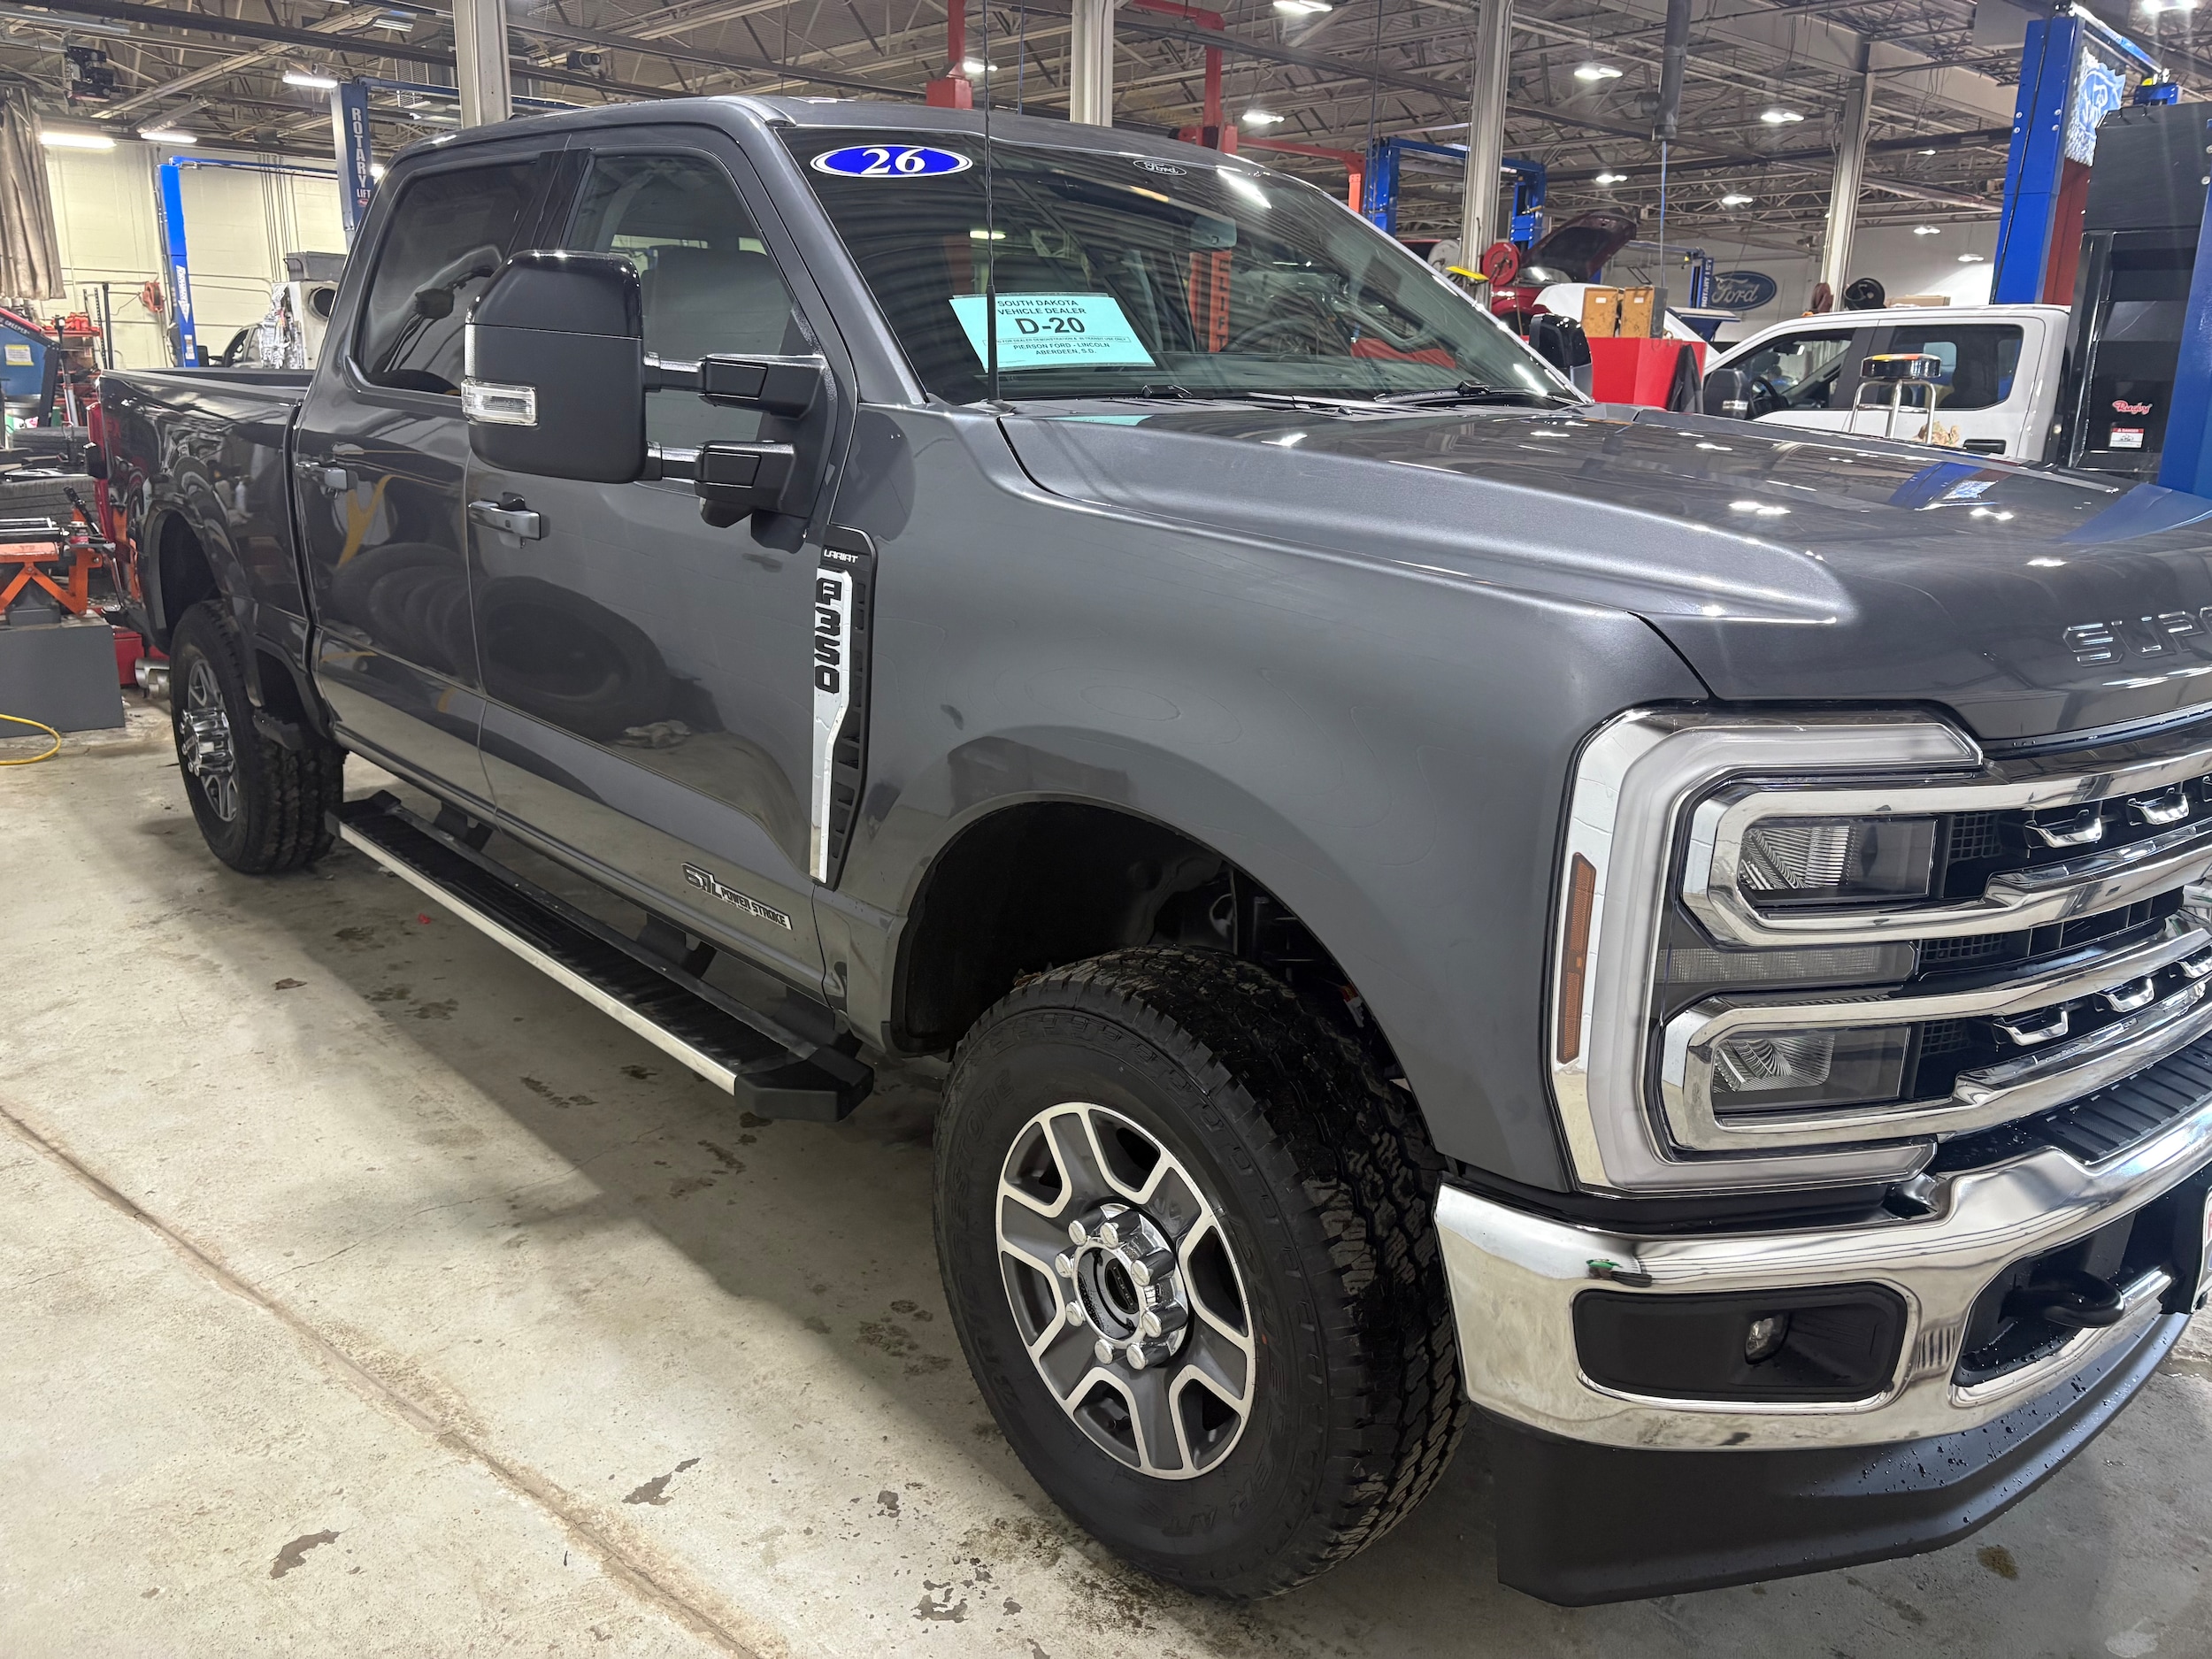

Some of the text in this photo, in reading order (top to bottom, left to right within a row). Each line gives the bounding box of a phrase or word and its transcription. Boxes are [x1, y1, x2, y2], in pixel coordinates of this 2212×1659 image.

[351, 107, 371, 198] ROTARY LIFT
[860, 148, 926, 174] 26
[1143, 161, 1179, 173] Ford
[1711, 275, 1760, 303] Ford
[1015, 318, 1085, 334] D-20
[2112, 400, 2153, 415] Rugby
[824, 549, 858, 563] LARIAT
[2062, 606, 2212, 667] SUP
[721, 887, 751, 910] POWER
[752, 902, 787, 928] STROKE
